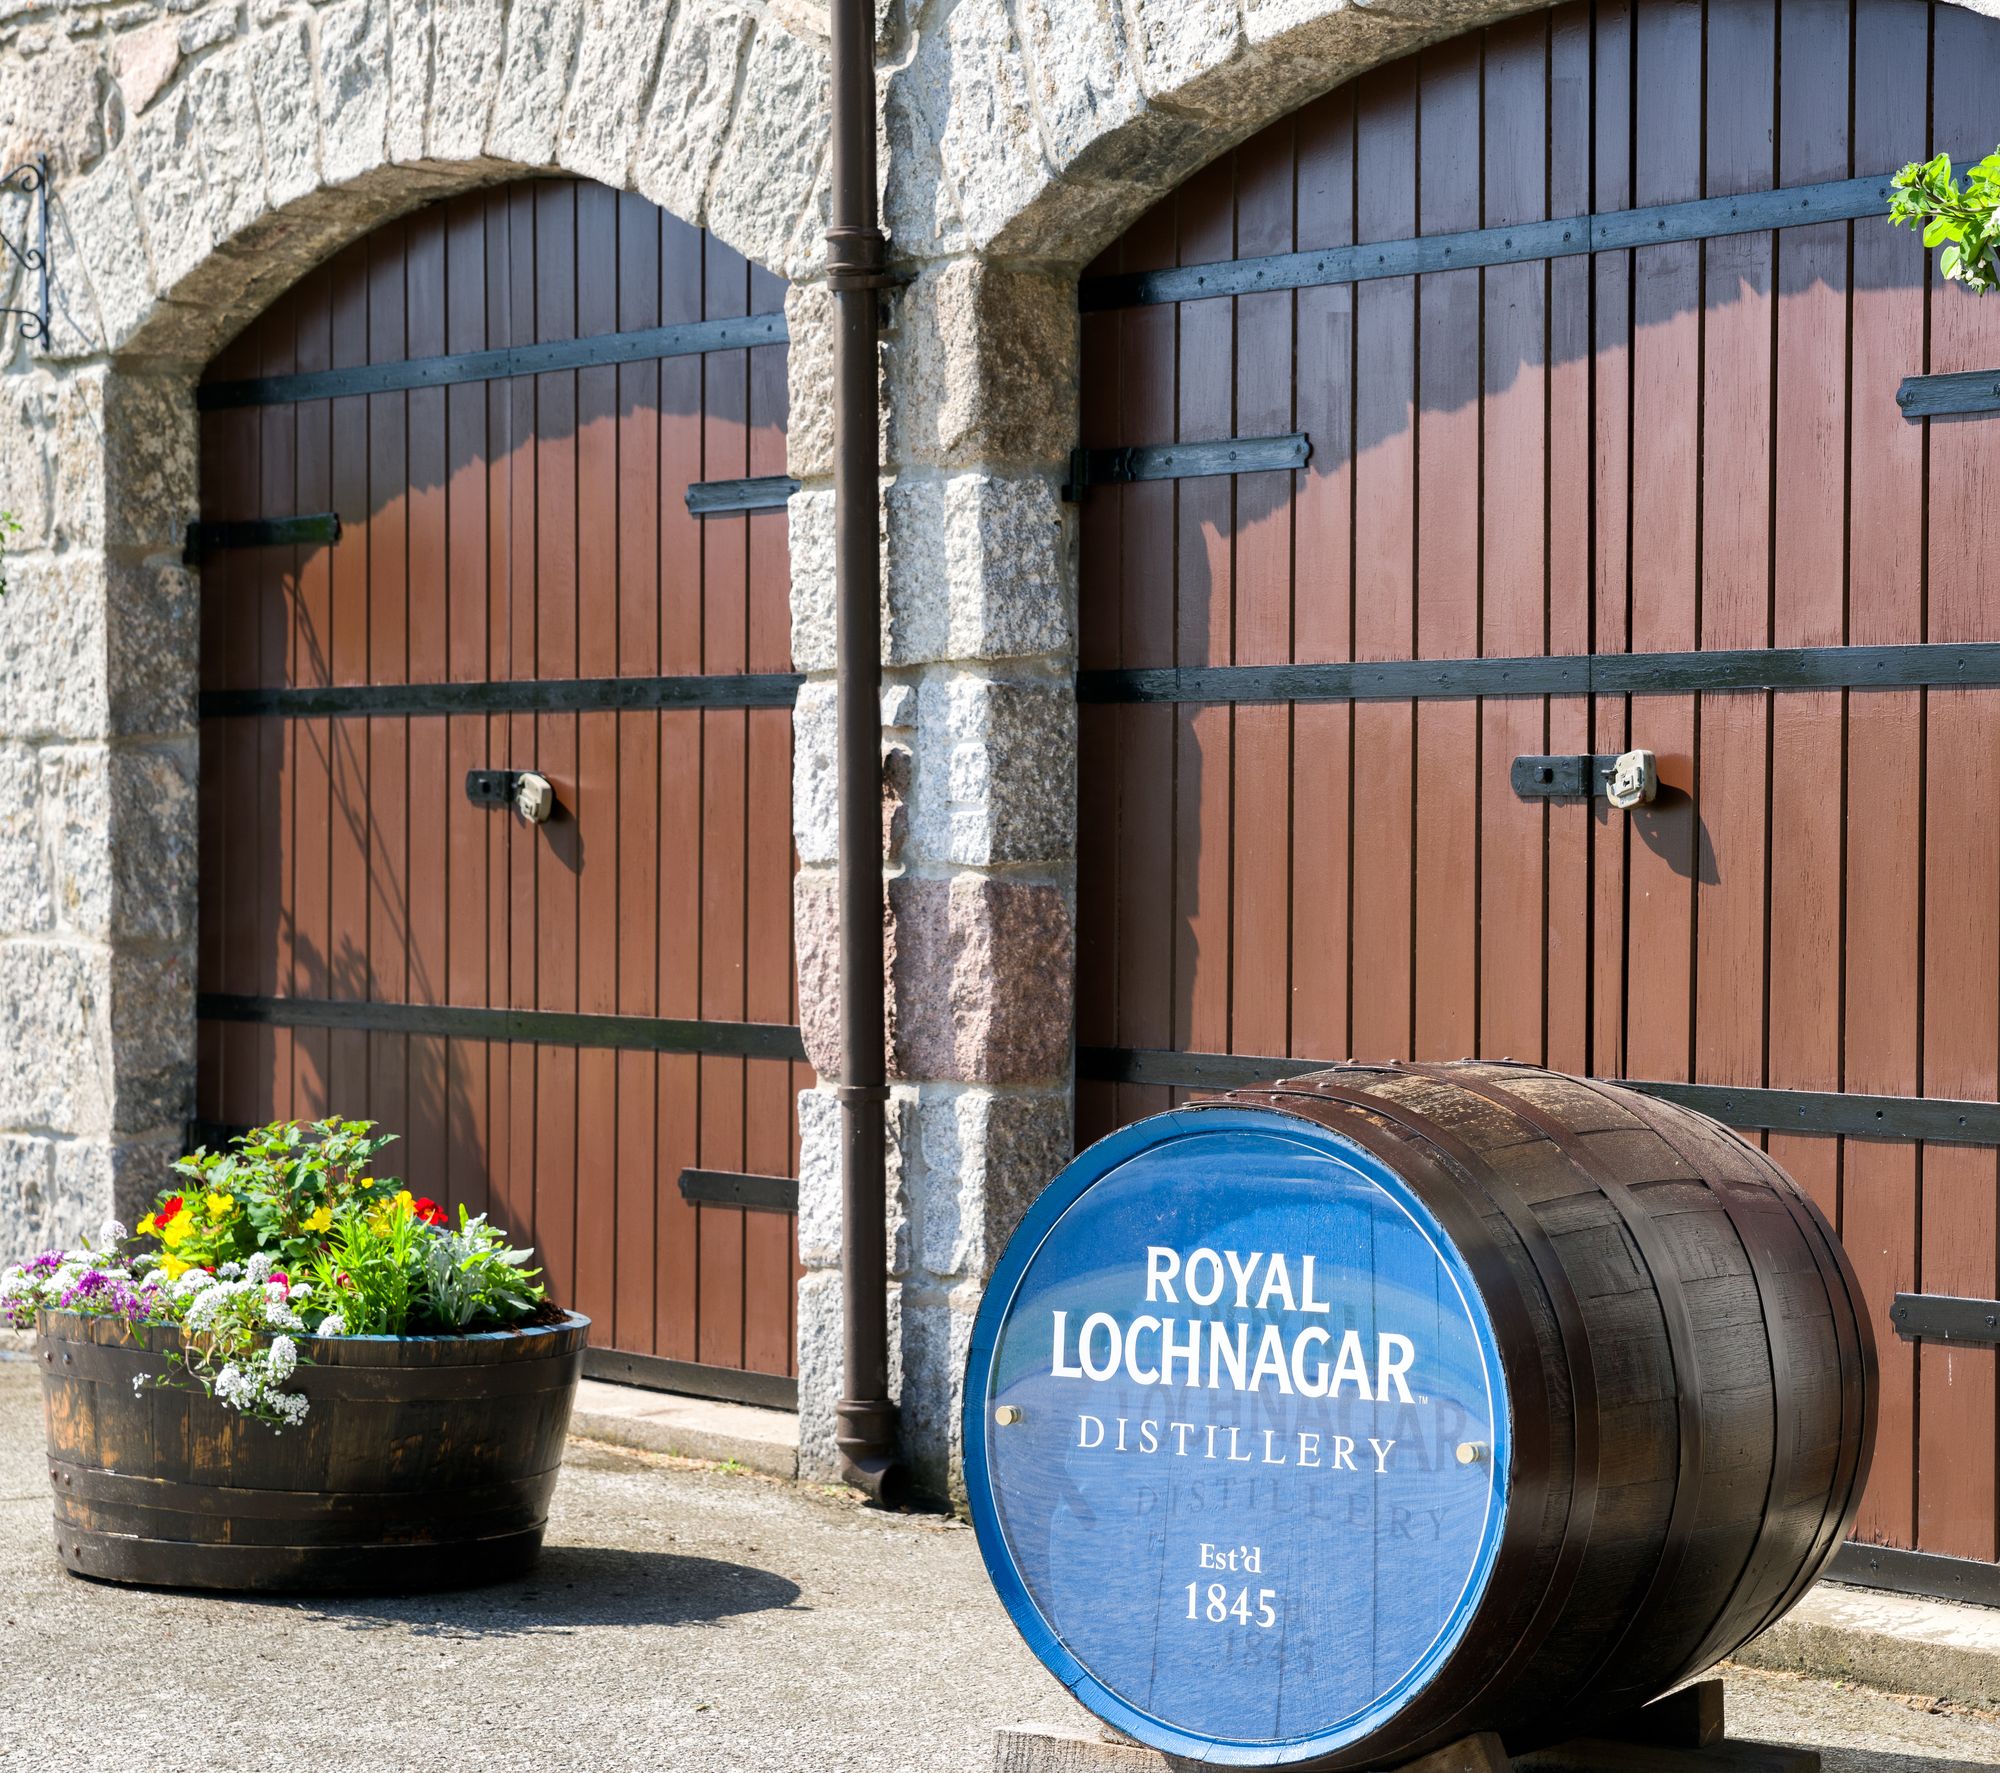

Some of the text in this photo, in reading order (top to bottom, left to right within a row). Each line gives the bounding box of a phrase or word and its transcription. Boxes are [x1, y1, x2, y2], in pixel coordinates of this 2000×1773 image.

[1145, 1246, 1330, 1313] ROYAL
[1050, 1310, 1416, 1404] LOCHNAGAR
[1077, 1414, 1396, 1474] DISTILLERY
[1199, 1542, 1262, 1574] Est’d
[1184, 1581, 1277, 1628] 1845
